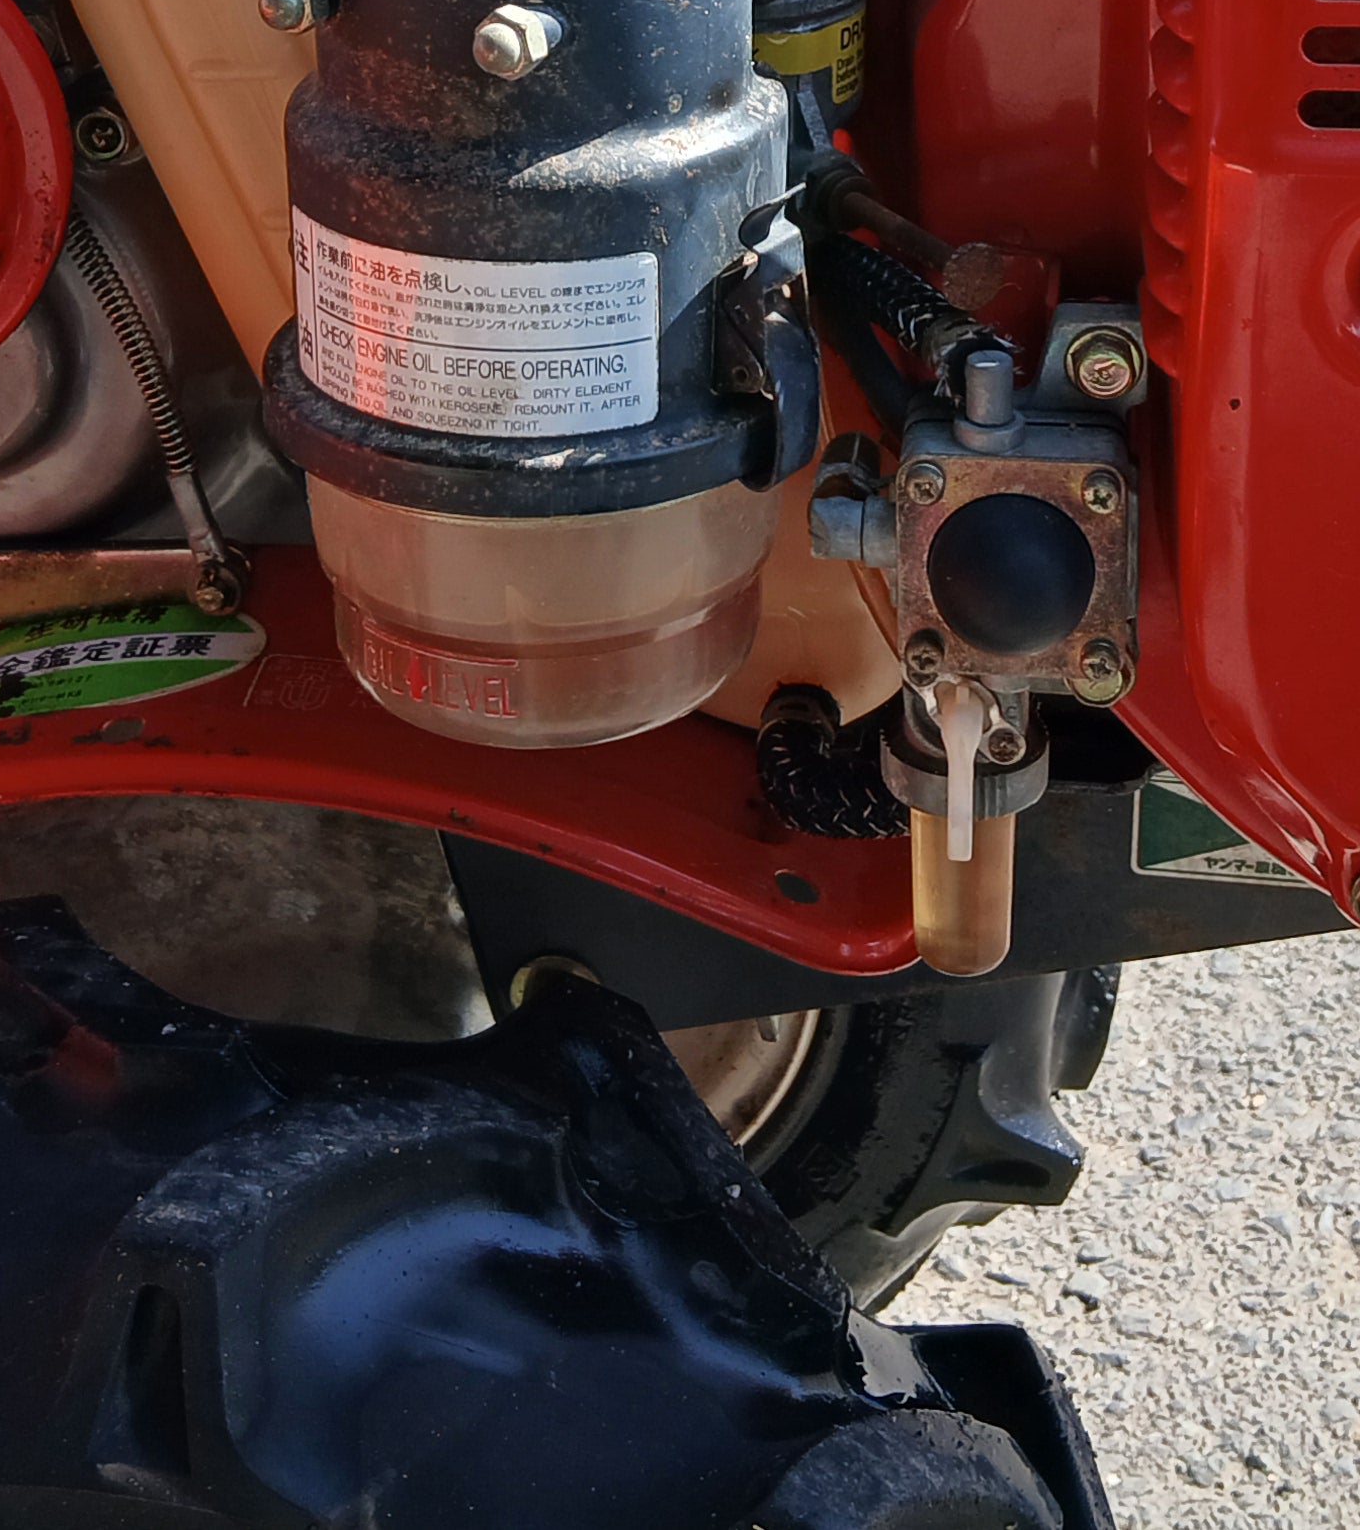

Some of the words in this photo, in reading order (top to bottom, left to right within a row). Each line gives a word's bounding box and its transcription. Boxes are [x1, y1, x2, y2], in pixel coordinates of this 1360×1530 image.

[501, 286, 546, 299] LEVEL
[320, 320, 354, 353] CHECK
[357, 336, 409, 369] ENGINE
[412, 352, 438, 375] OIL
[443, 356, 517, 381] BEFORE
[355, 363, 387, 381] ENGINE
[390, 374, 407, 387] OIL
[410, 378, 426, 390] TO
[431, 383, 453, 395] THE
[458, 386, 476, 398] OIL
[533, 387, 570, 400] DIRTY
[575, 380, 632, 398] ELEMENT
[367, 381, 407, 401] WASHED
[409, 393, 436, 408] WITH
[515, 402, 575, 416] REMOUNT
[601, 395, 641, 411] AFTER
[392, 405, 414, 419] AND
[417, 411, 482, 430] SQUEEZING
[486, 418, 497, 430] IT
[364, 639, 403, 695] OIL
[428, 664, 518, 719] LEVEL
